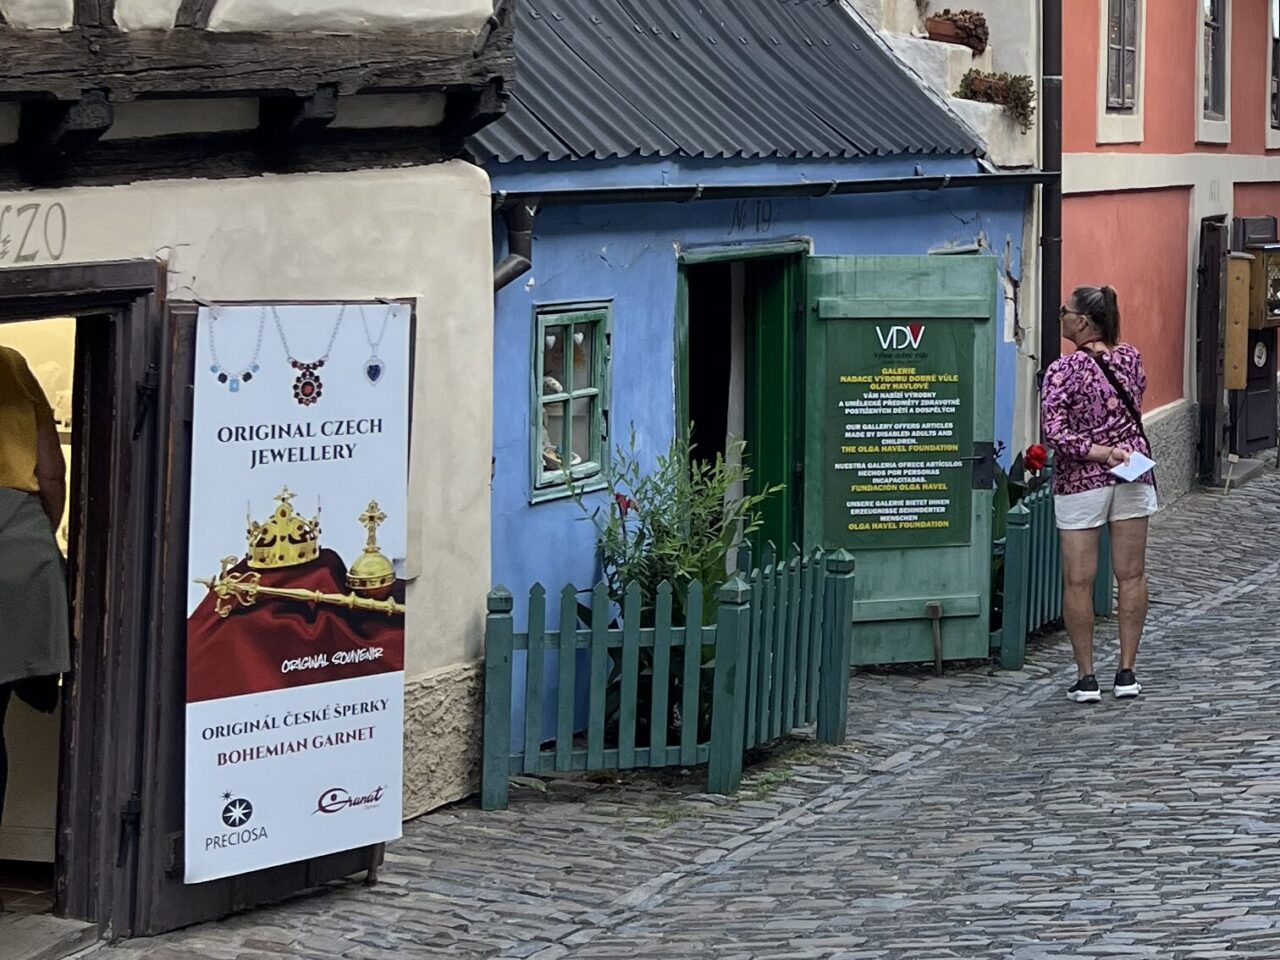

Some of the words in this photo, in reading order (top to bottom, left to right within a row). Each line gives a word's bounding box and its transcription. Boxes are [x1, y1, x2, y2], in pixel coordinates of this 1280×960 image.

[13, 202, 67, 263] 20
[876, 325, 925, 350] VDV
[840, 375, 873, 383] NADACE
[881, 367, 917, 375] GALERIE
[217, 422, 317, 443] ORIGINAL
[320, 418, 383, 436] CZECH
[250, 443, 357, 469] JEWELLERY
[858, 445, 879, 453] OLGA
[908, 444, 959, 452] FOUNDATION
[922, 483, 948, 491] HAVEL
[899, 521, 949, 529] FOUNDATION
[281, 653, 329, 673] ORIGINAL
[331, 647, 384, 665] SOUVENIR
[202, 714, 280, 740] ORIGINÁL
[283, 704, 331, 727] ČESKÉ
[333, 698, 390, 719] ŠPERKY
[217, 738, 308, 766] BOHEMIAN
[312, 726, 376, 749] GARNET
[205, 826, 268, 851] PRECIOSA
